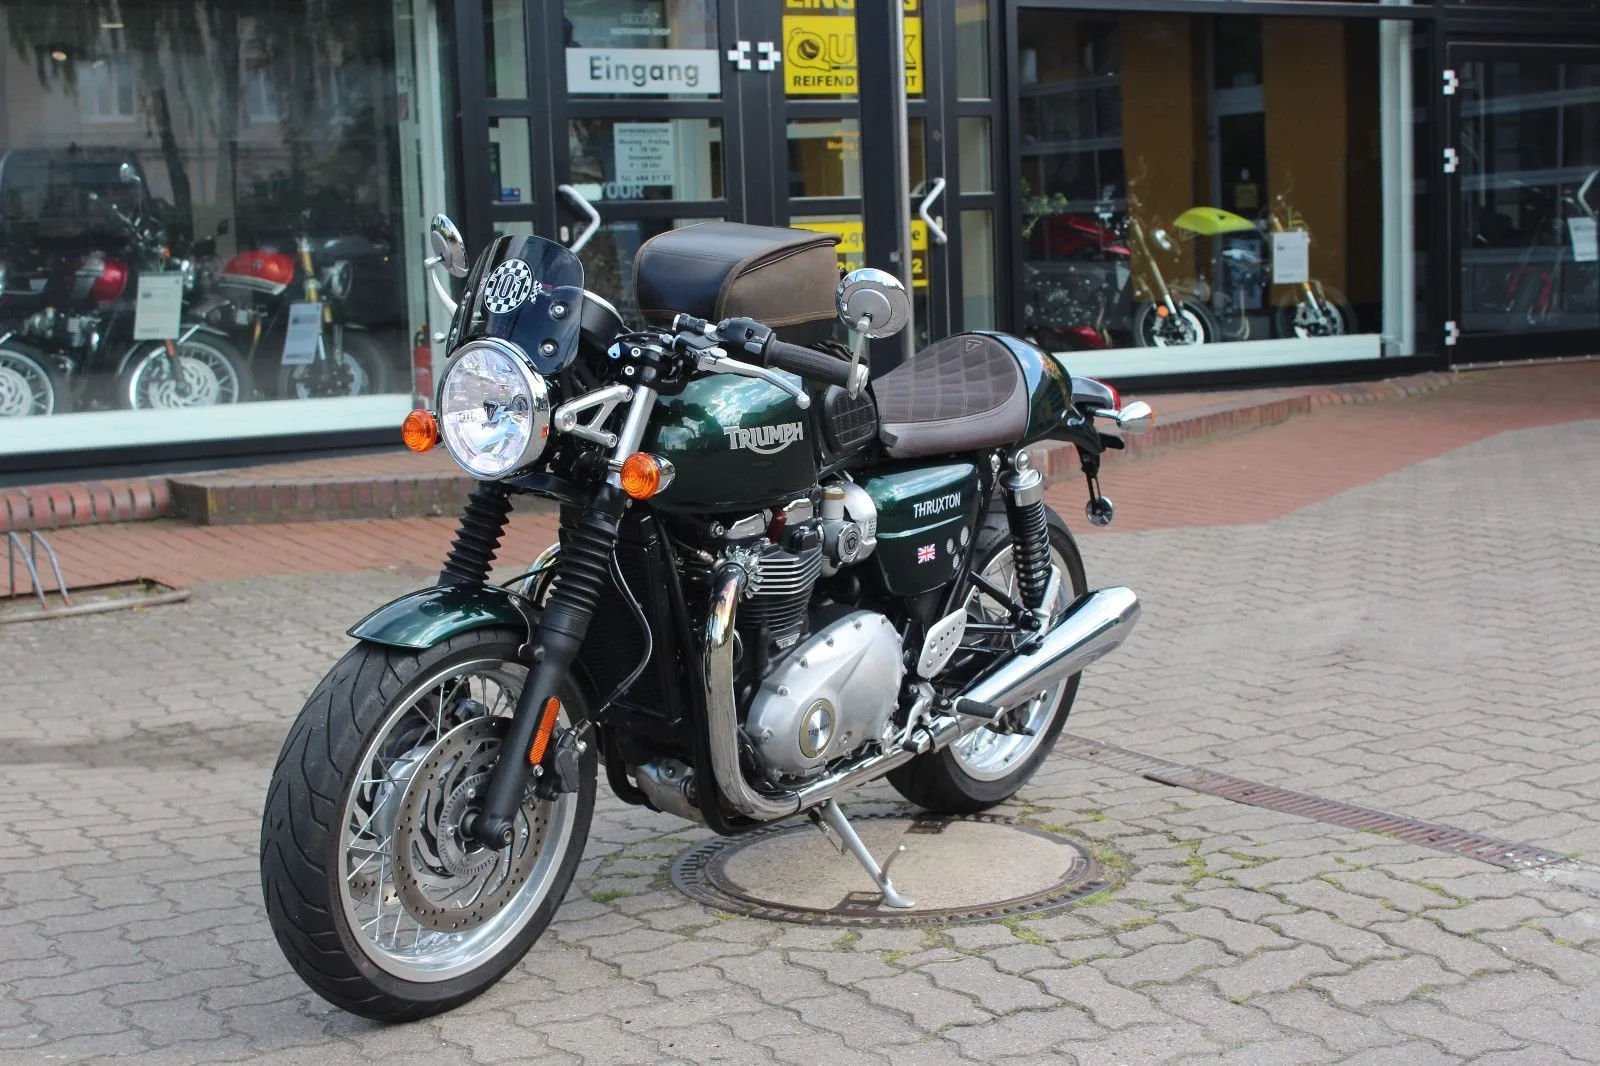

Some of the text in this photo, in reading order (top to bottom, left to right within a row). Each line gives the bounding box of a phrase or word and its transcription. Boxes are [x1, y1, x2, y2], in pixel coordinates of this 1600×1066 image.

[589, 55, 699, 87] Eingang
[490, 273, 529, 302] 101
[723, 422, 804, 455] TRIUMPH
[913, 491, 961, 518] THRUXTON
